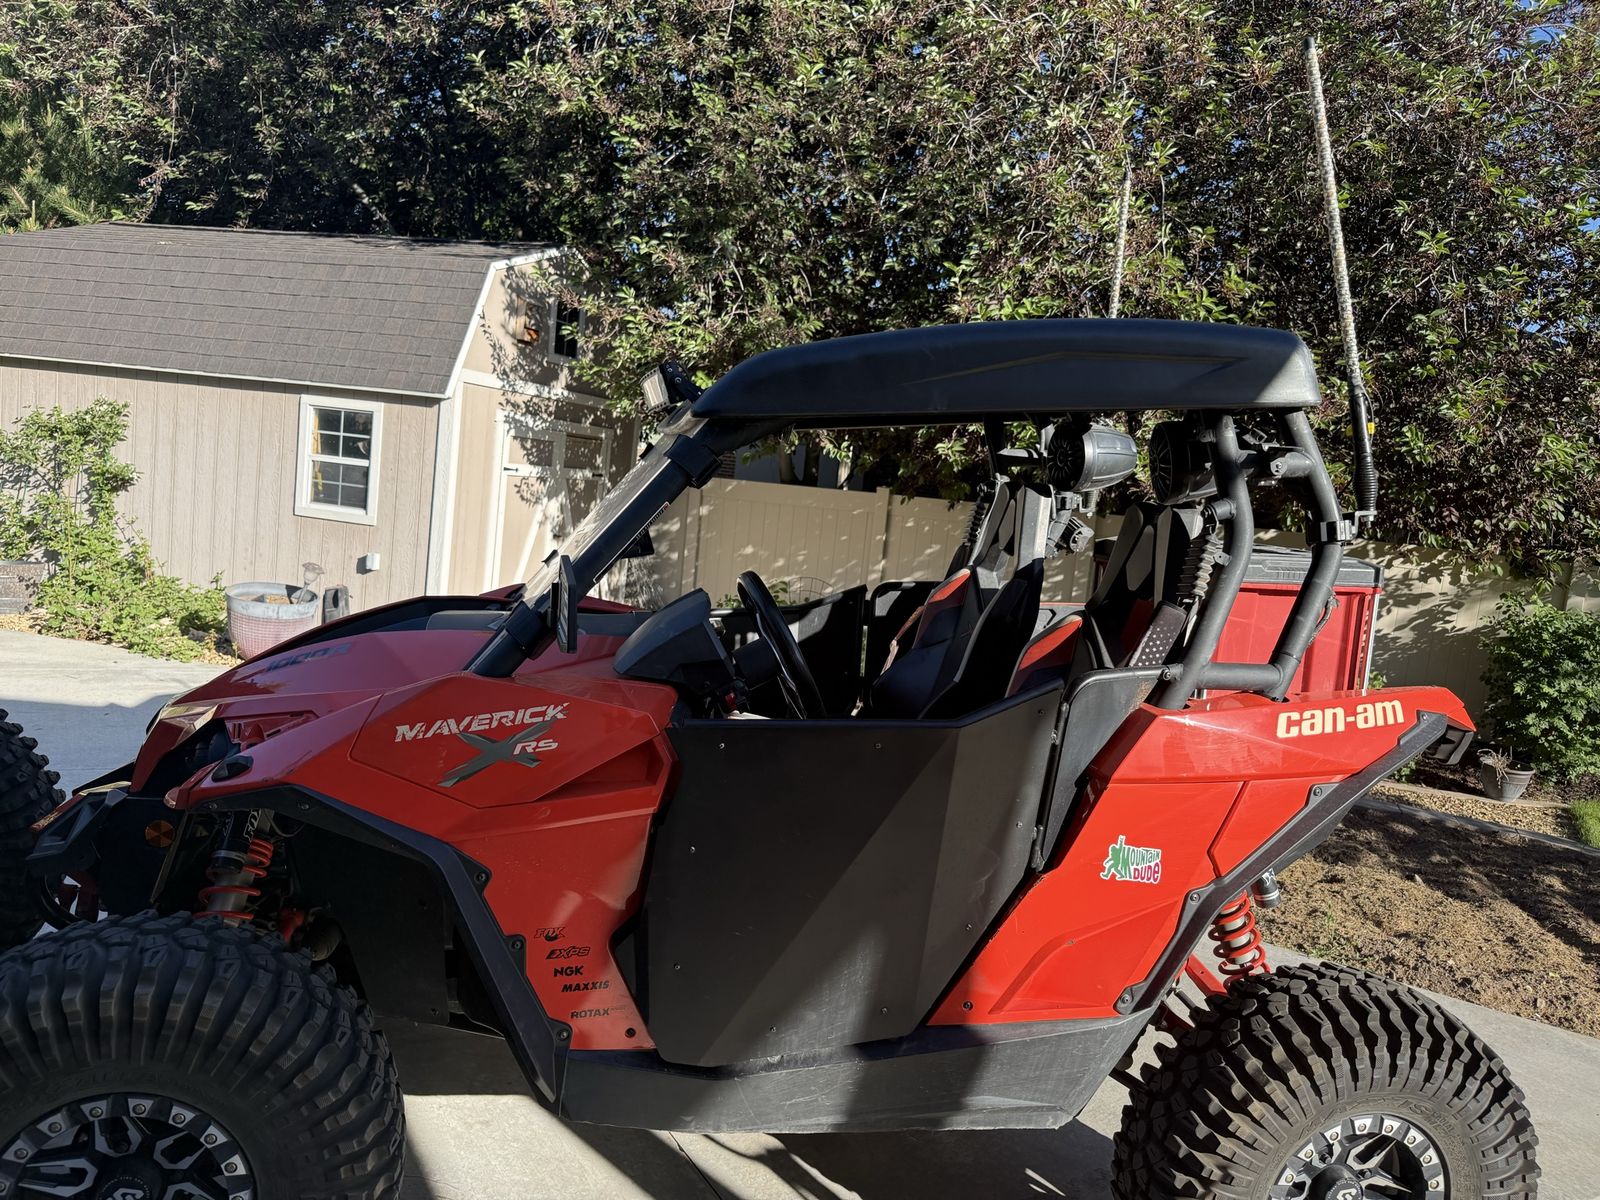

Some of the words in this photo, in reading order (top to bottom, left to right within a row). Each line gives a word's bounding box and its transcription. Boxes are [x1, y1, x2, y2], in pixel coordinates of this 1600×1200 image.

[394, 702, 570, 743] MAVERICK
[1276, 699, 1405, 738] can-am
[553, 965, 584, 977] NGK
[561, 981, 610, 992] MAXXIS
[570, 1008, 610, 1019] ROTAX
